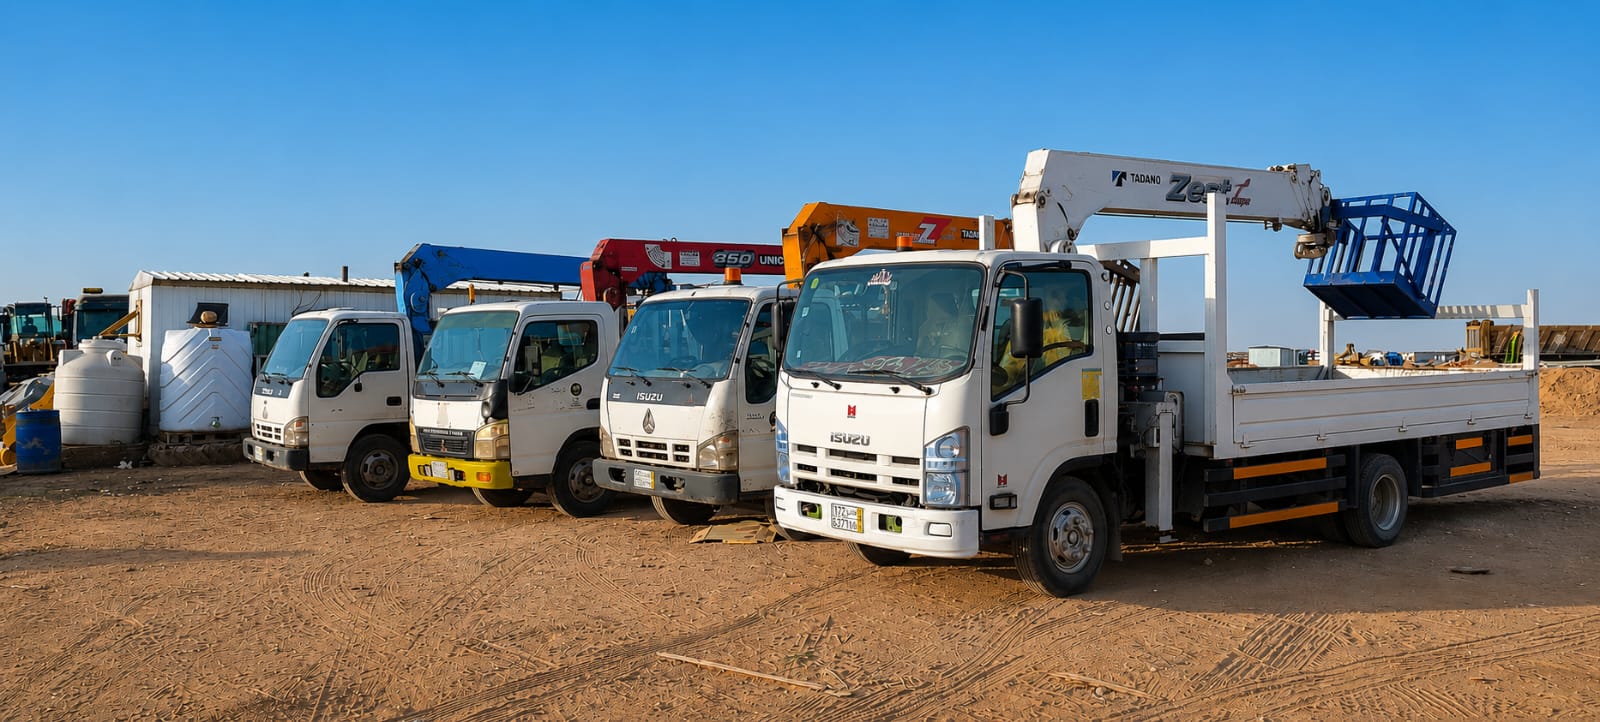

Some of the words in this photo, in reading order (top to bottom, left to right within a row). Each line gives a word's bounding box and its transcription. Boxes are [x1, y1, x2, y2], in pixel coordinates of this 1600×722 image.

[1130, 173, 1161, 184] TADANO
[760, 255, 784, 265] UNIC
[636, 391, 664, 402] ISUZU
[830, 432, 871, 446] ISUZU
